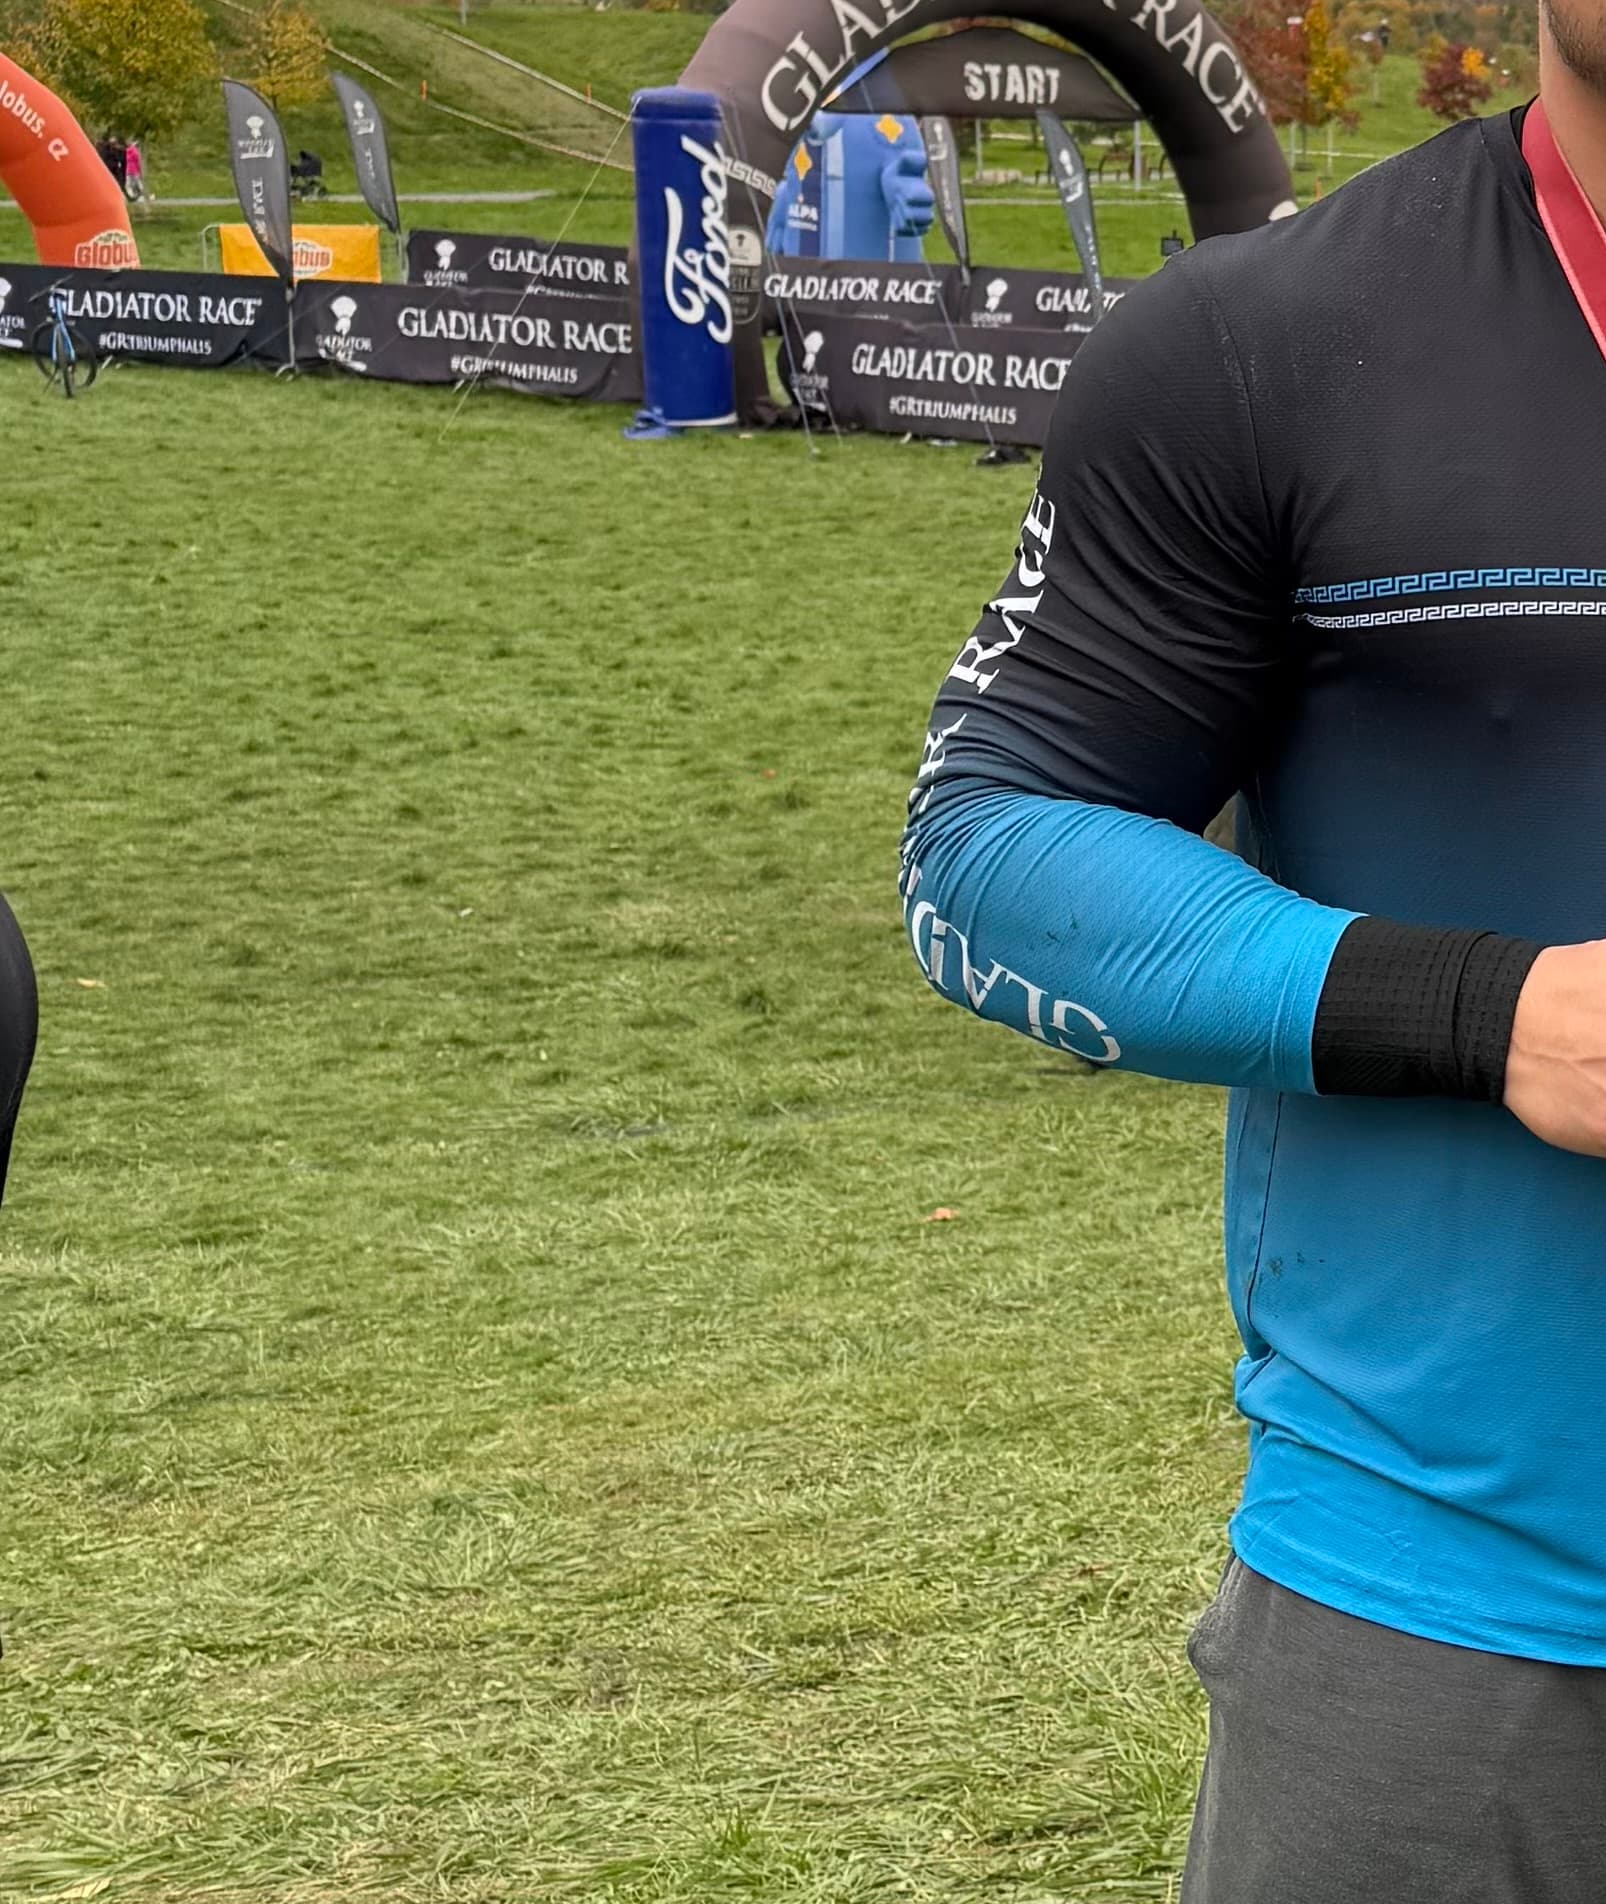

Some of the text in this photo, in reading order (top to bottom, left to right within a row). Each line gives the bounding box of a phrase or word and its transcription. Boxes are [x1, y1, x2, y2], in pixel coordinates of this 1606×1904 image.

[963, 61, 1060, 104] START
[664, 133, 733, 344] Ford
[488, 247, 609, 284] GLADIATOR
[50, 286, 256, 327] GLADIATOR RACE
[764, 273, 879, 302] GLADIATOR
[884, 278, 939, 305] RACE
[397, 306, 633, 355] GLADIATOR RACE
[852, 343, 996, 387] GLADIATOR
[890, 395, 1016, 425] #GRTRIUMPHALIS
[947, 494, 1056, 695] RACE
